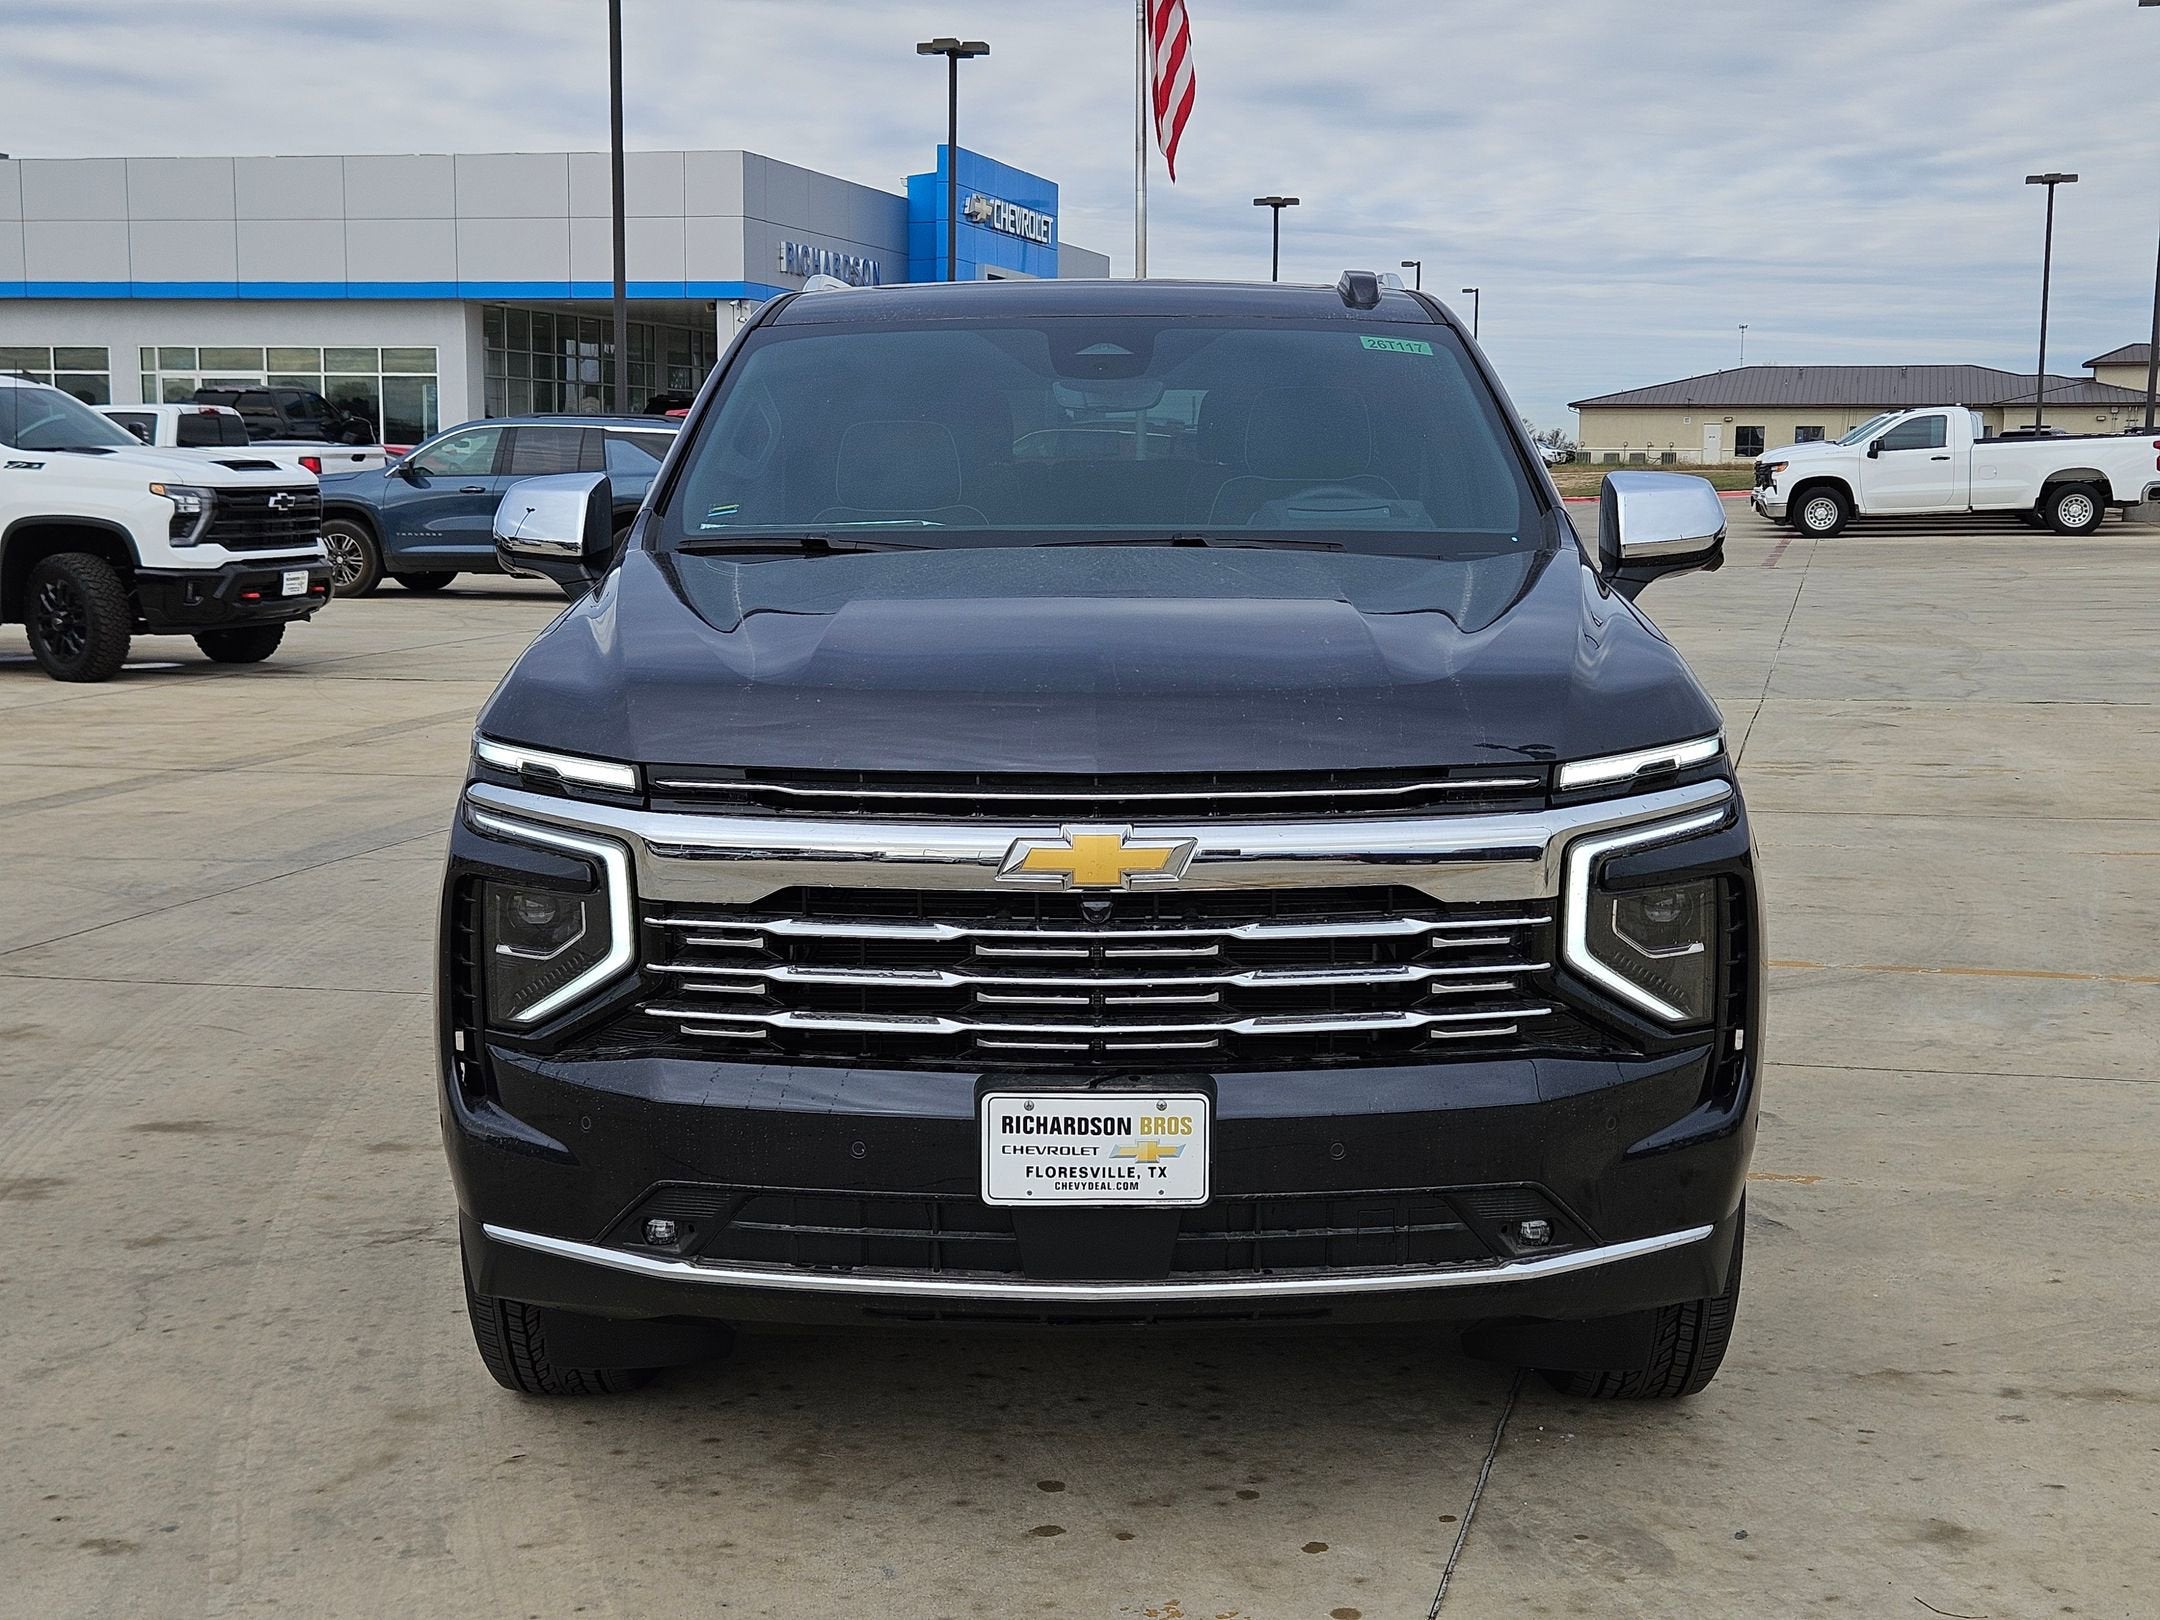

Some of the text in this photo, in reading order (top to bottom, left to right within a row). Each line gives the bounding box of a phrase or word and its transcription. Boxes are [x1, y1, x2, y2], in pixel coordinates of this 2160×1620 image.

[993, 199, 1053, 244] CHEVROLET
[781, 241, 880, 286] RICHARDSON
[1367, 339, 1423, 352] 26T117
[1002, 1115, 1193, 1136] RICHARDSON BROS
[1001, 1145, 1100, 1156] CHEVROLET
[1026, 1166, 1167, 1179] FLORESVILLE, TX
[1055, 1181, 1139, 1190] CHEVYDEAL.COM
